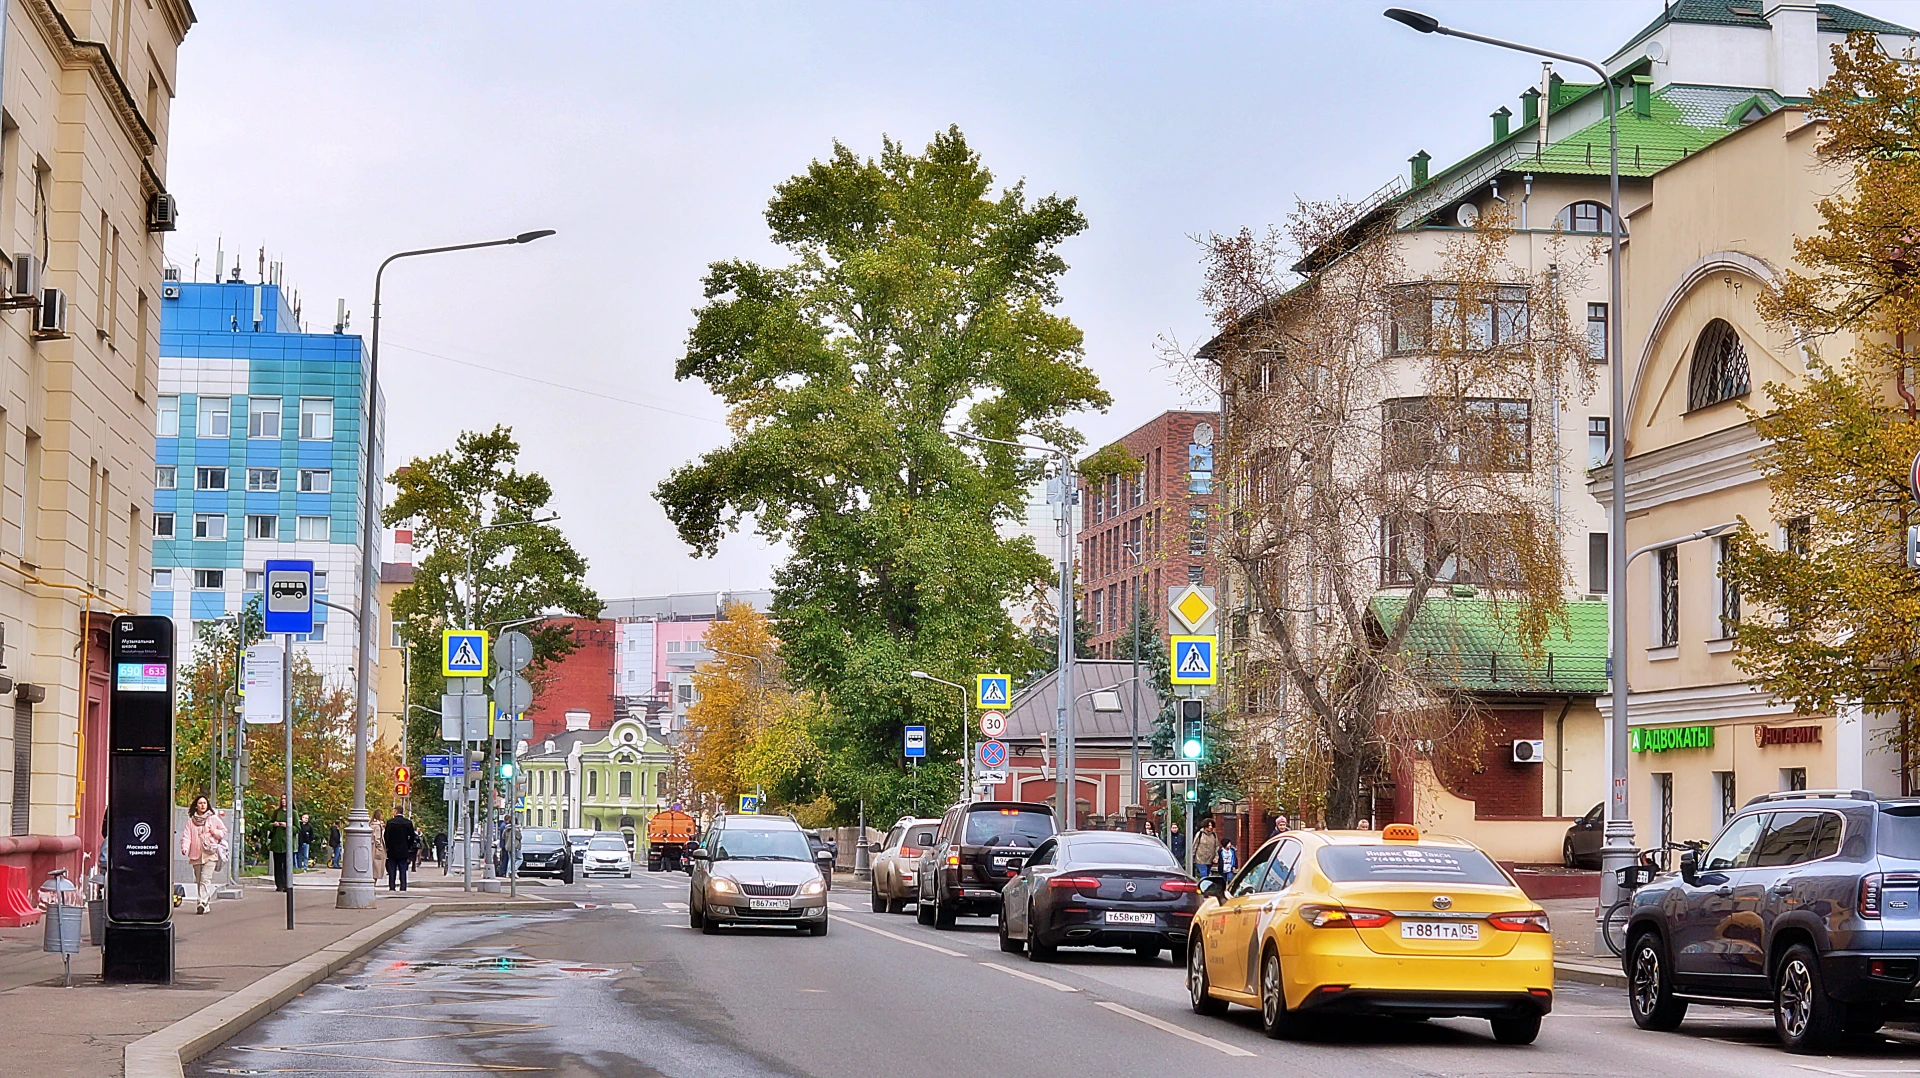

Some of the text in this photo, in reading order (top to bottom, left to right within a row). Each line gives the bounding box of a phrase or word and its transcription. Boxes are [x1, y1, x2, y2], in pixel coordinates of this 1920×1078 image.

[120, 666, 140, 676] 690
[986, 718, 1001, 730] 30
[1191, 720, 1202, 739] 12
[1644, 726, 1710, 753] АДВОКАТЫ
[1765, 726, 1820, 745] НОТАРИУС
[1147, 763, 1191, 777] СТОП
[1108, 912, 1140, 921] Т658КВ
[1407, 924, 1474, 938] Т881ТА 05
